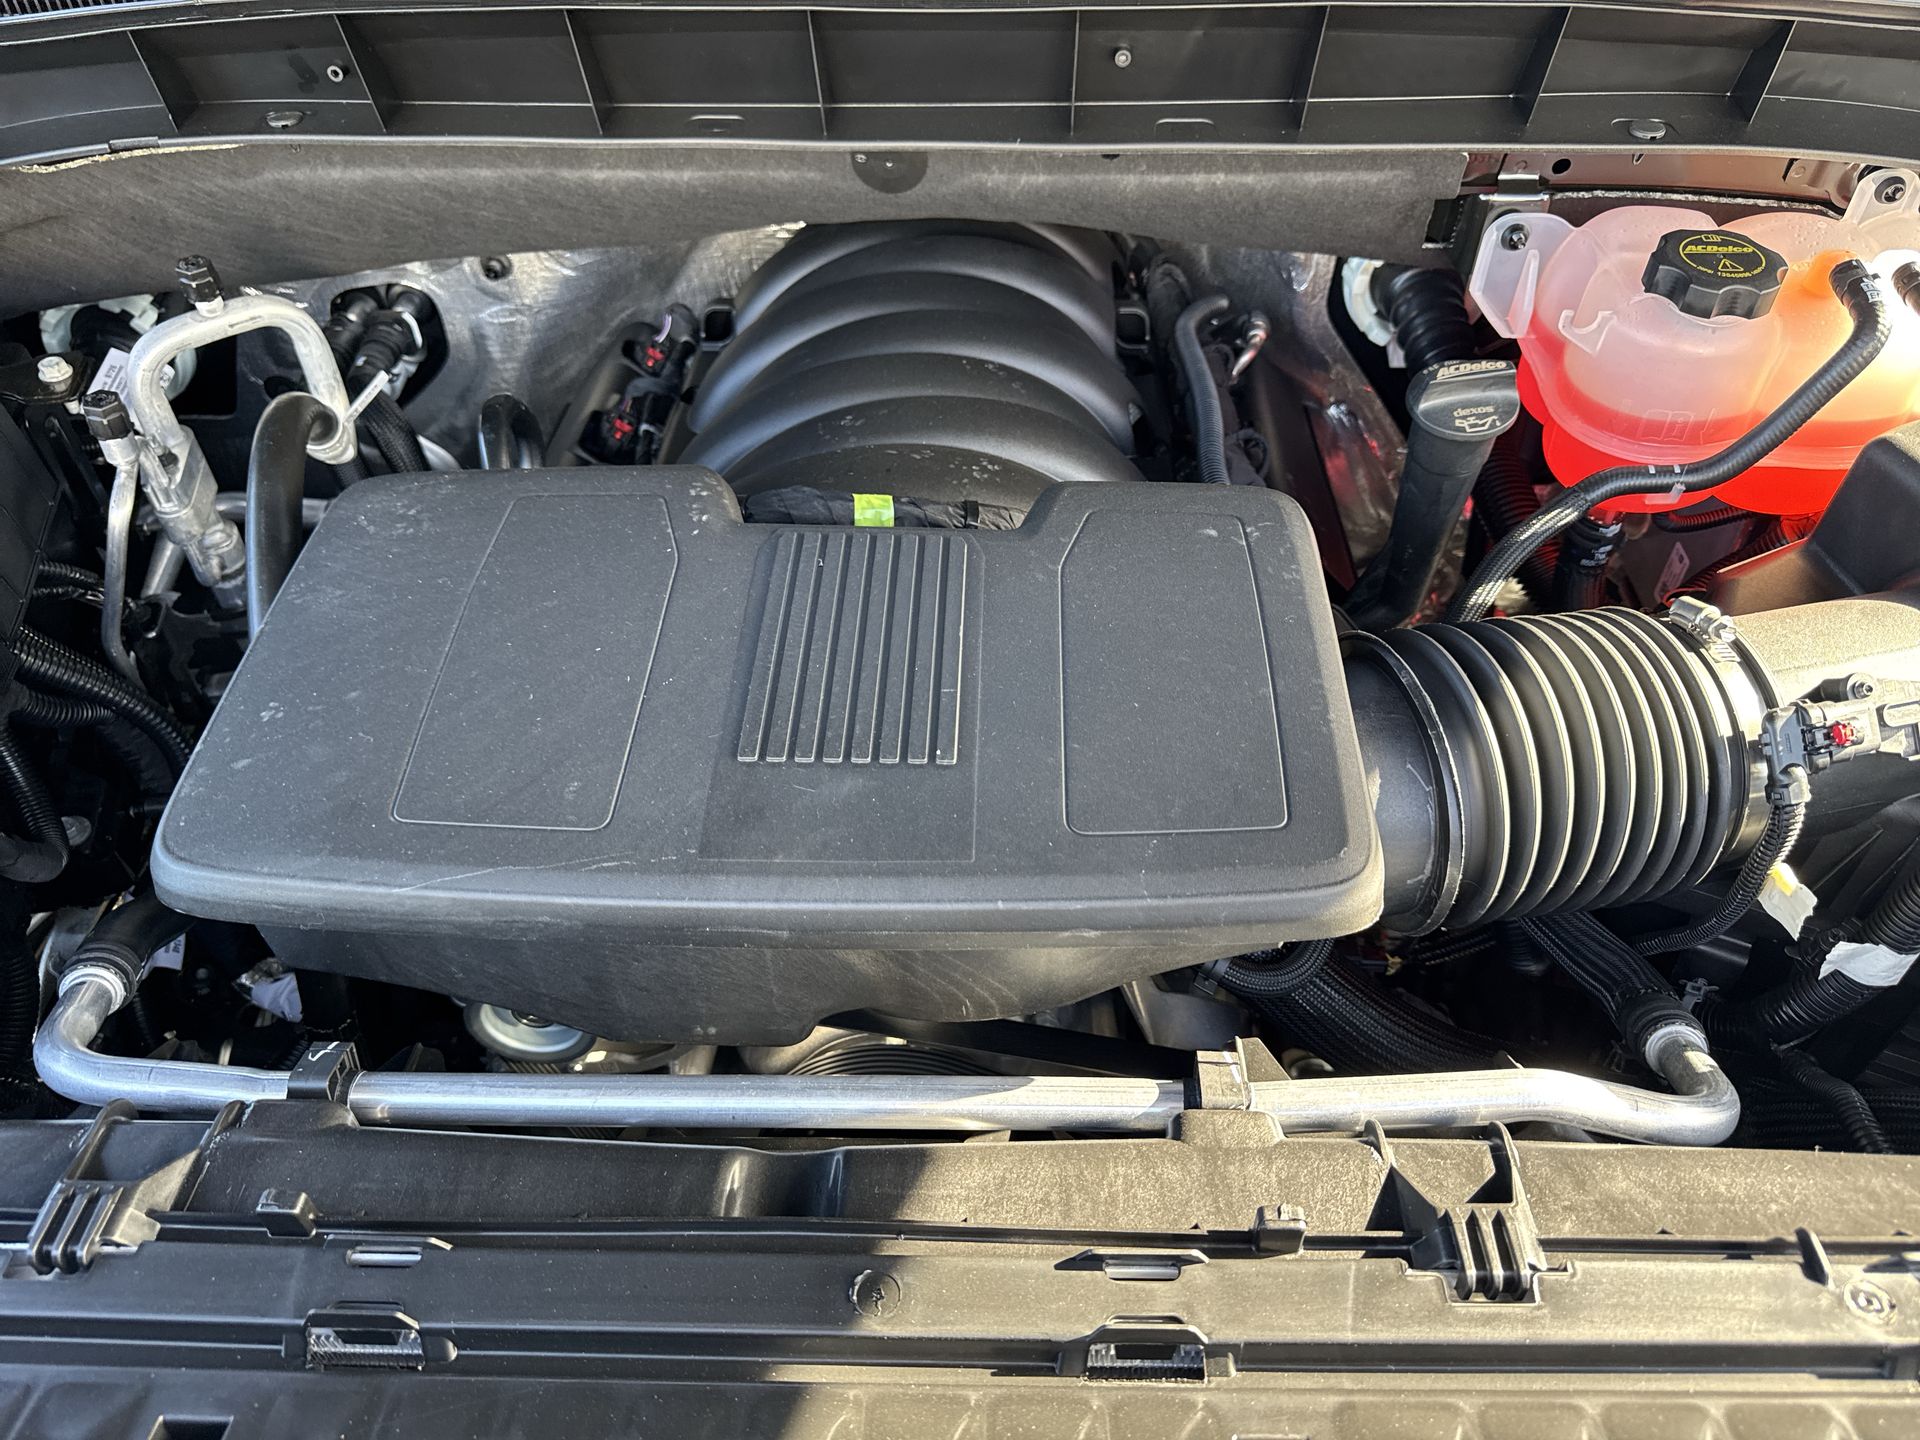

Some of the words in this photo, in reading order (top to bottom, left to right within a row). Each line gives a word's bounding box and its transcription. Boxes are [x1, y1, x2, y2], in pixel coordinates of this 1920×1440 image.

[1683, 245, 1754, 254] ACDelco
[1436, 361, 1507, 379] ACDelco
[1453, 405, 1495, 418] dexos
